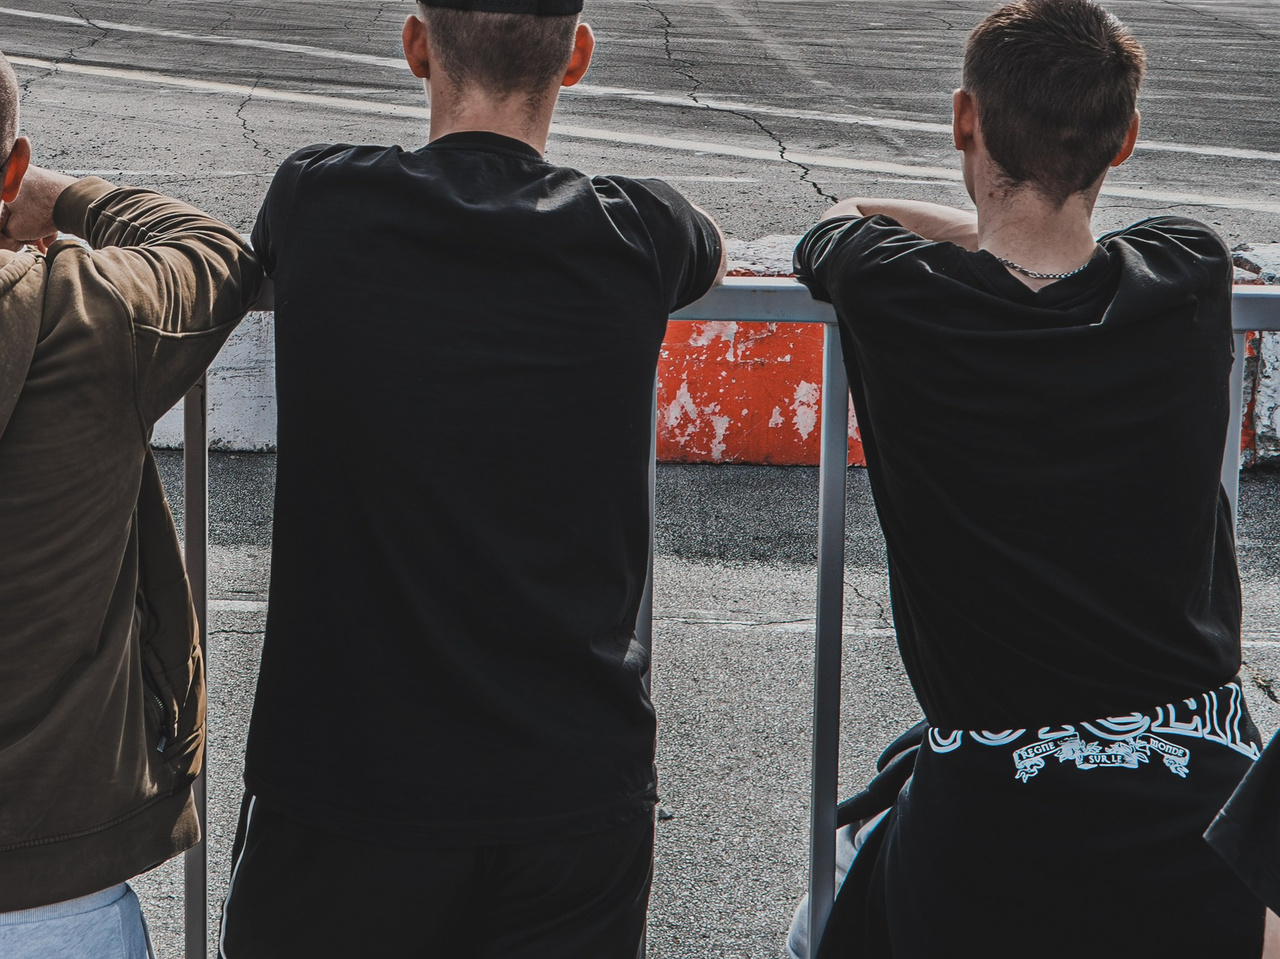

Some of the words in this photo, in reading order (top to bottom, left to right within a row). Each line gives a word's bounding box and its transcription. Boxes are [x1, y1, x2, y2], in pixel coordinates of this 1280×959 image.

[1021, 741, 1056, 760] REGNE
[1088, 754, 1111, 763] SUR
[1112, 754, 1122, 764] LE
[1149, 738, 1184, 757] MONDE
